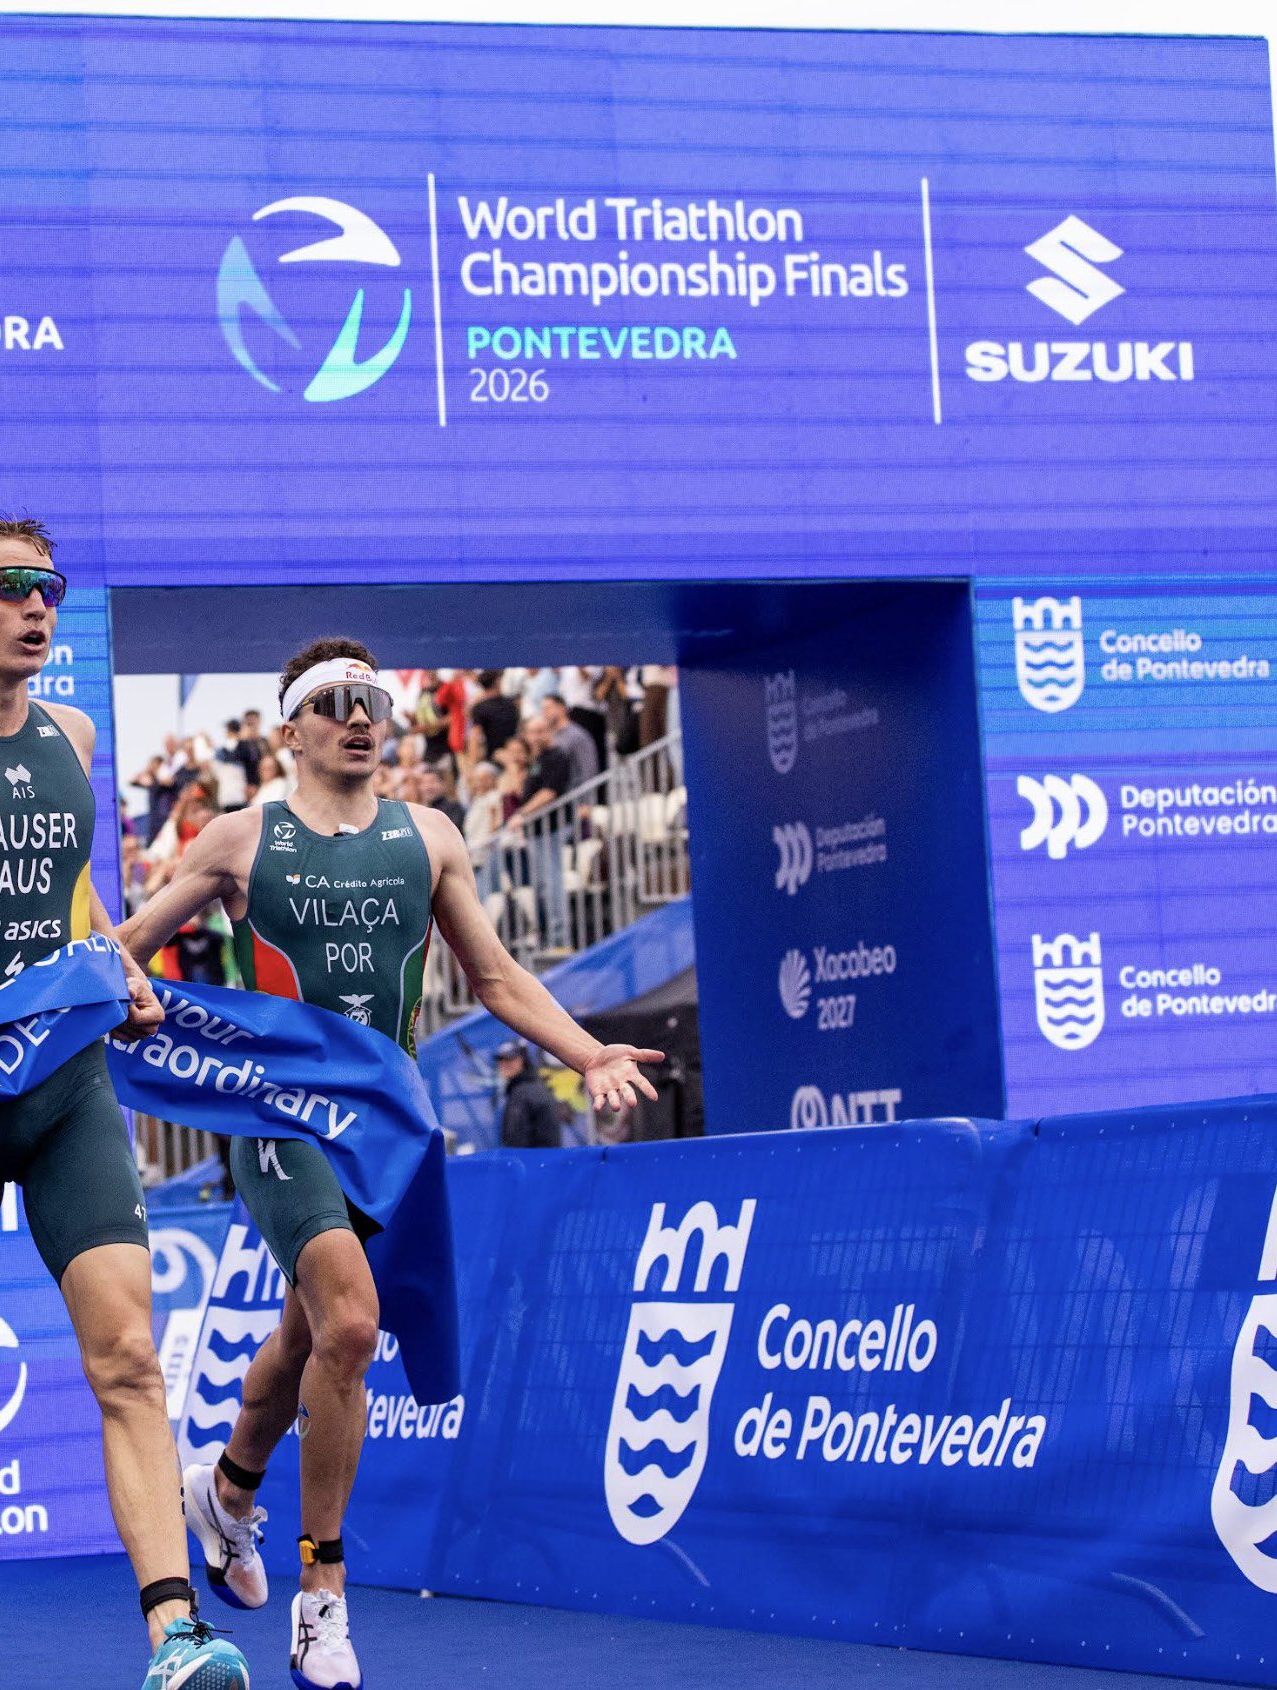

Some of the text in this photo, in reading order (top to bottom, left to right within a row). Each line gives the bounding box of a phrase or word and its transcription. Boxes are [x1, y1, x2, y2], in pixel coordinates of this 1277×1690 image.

[457, 196, 804, 243] World Triathlon
[459, 250, 909, 306] Championship Finals
[466, 326, 738, 361] PONTEVEDRA
[964, 341, 1195, 382] SUZUKI
[468, 367, 551, 404] 2026
[1099, 628, 1203, 654] Concello
[1101, 656, 1272, 683] de Pontevedra
[12, 785, 36, 800] AIS
[1120, 777, 1277, 813] Deputación
[1122, 810, 1277, 839] Pontevedra
[305, 874, 331, 889] CA
[333, 878, 367, 889] Crédito
[289, 897, 400, 934] VILAÇA
[325, 942, 375, 974] POR
[1119, 964, 1222, 989] Concello
[1121, 988, 1277, 1019] de Pontevedr
[756, 1302, 938, 1374] Concello
[733, 1394, 1047, 1469] de Pontevedra
